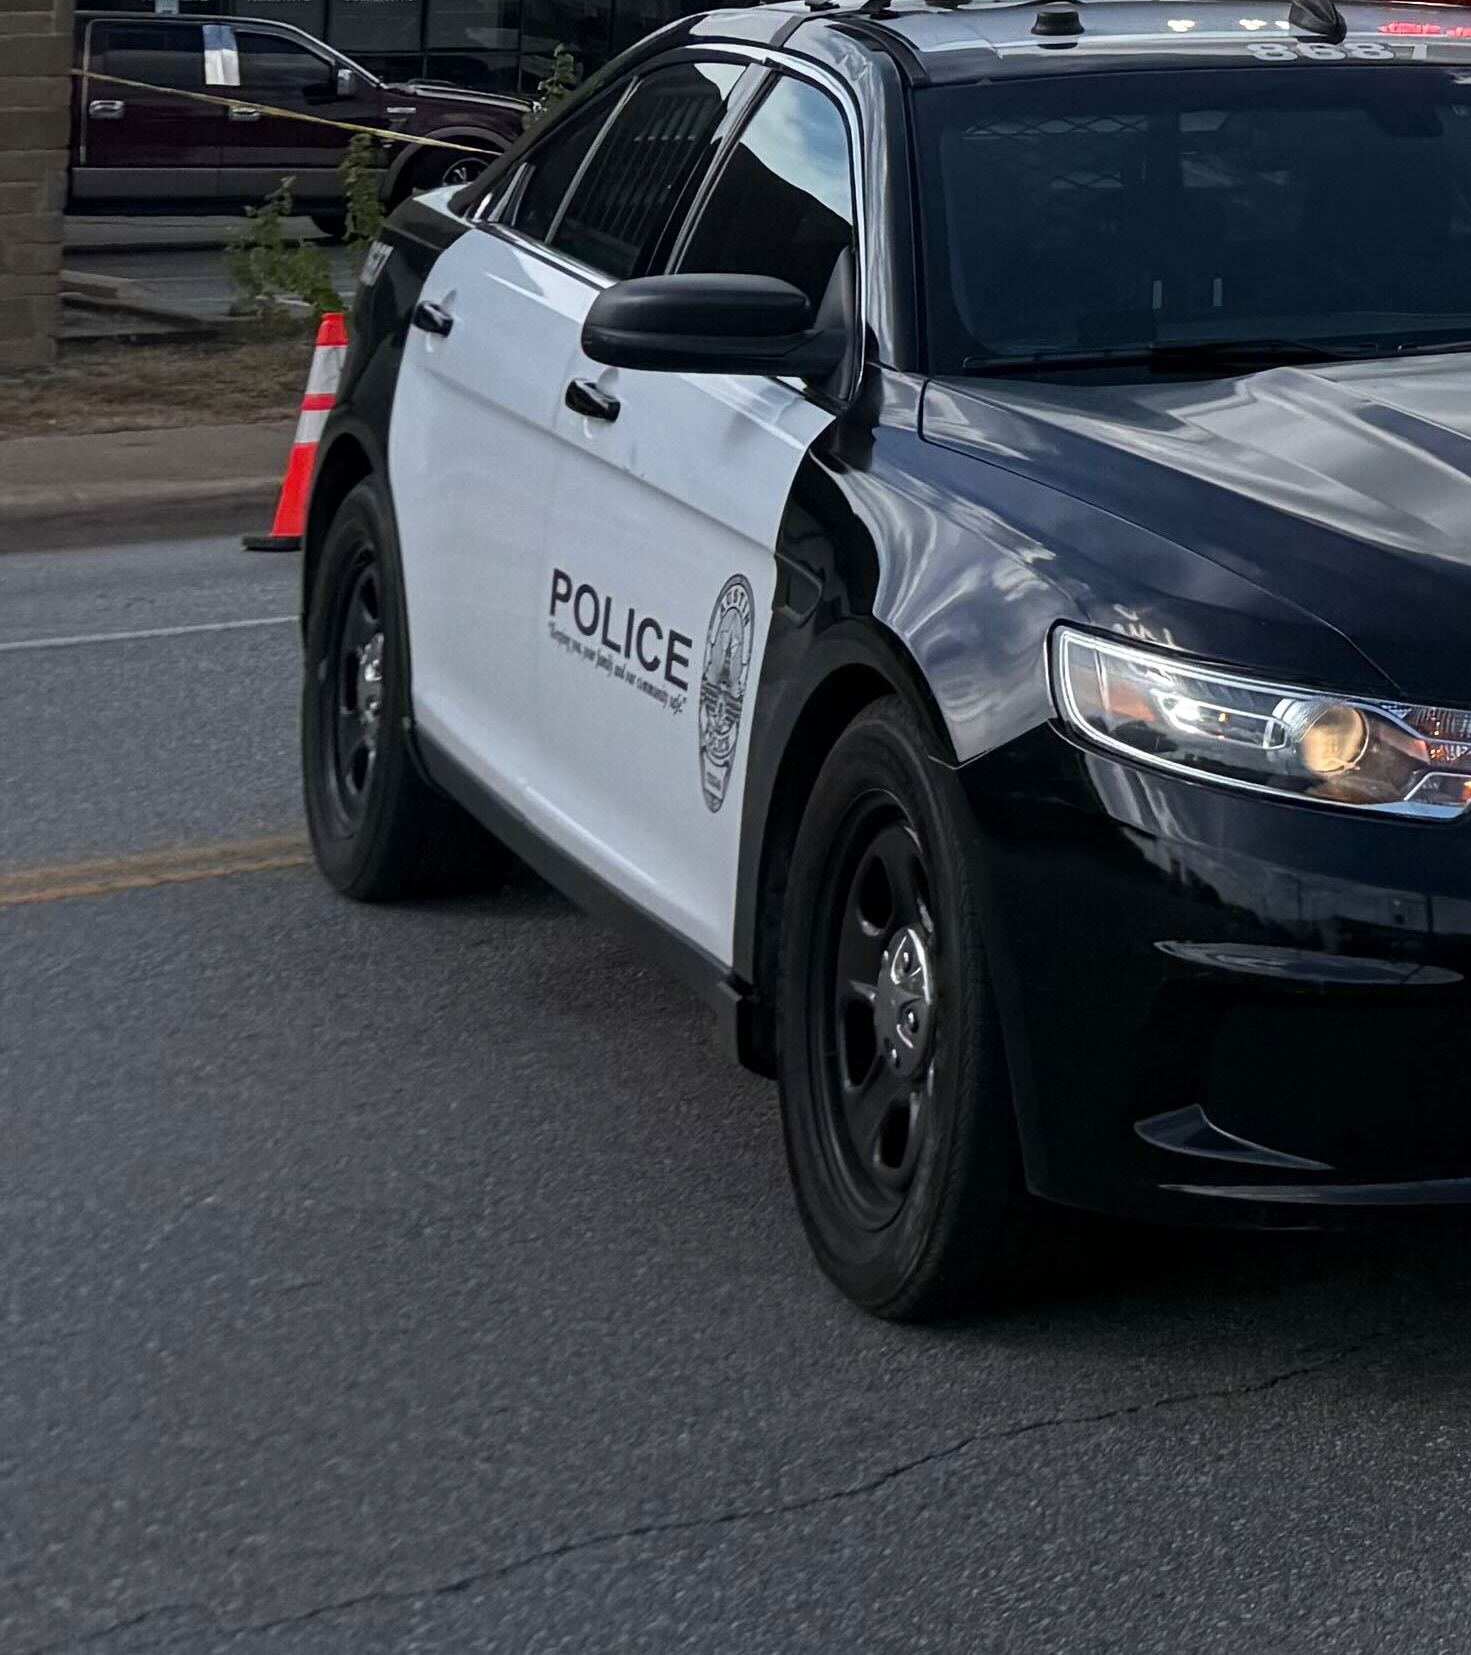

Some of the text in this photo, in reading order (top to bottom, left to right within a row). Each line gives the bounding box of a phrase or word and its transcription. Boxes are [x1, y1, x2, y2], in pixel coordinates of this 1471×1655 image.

[1246, 41, 1428, 62] 8687
[719, 588, 751, 627] AUSTIN
[549, 567, 693, 692] POLICE
